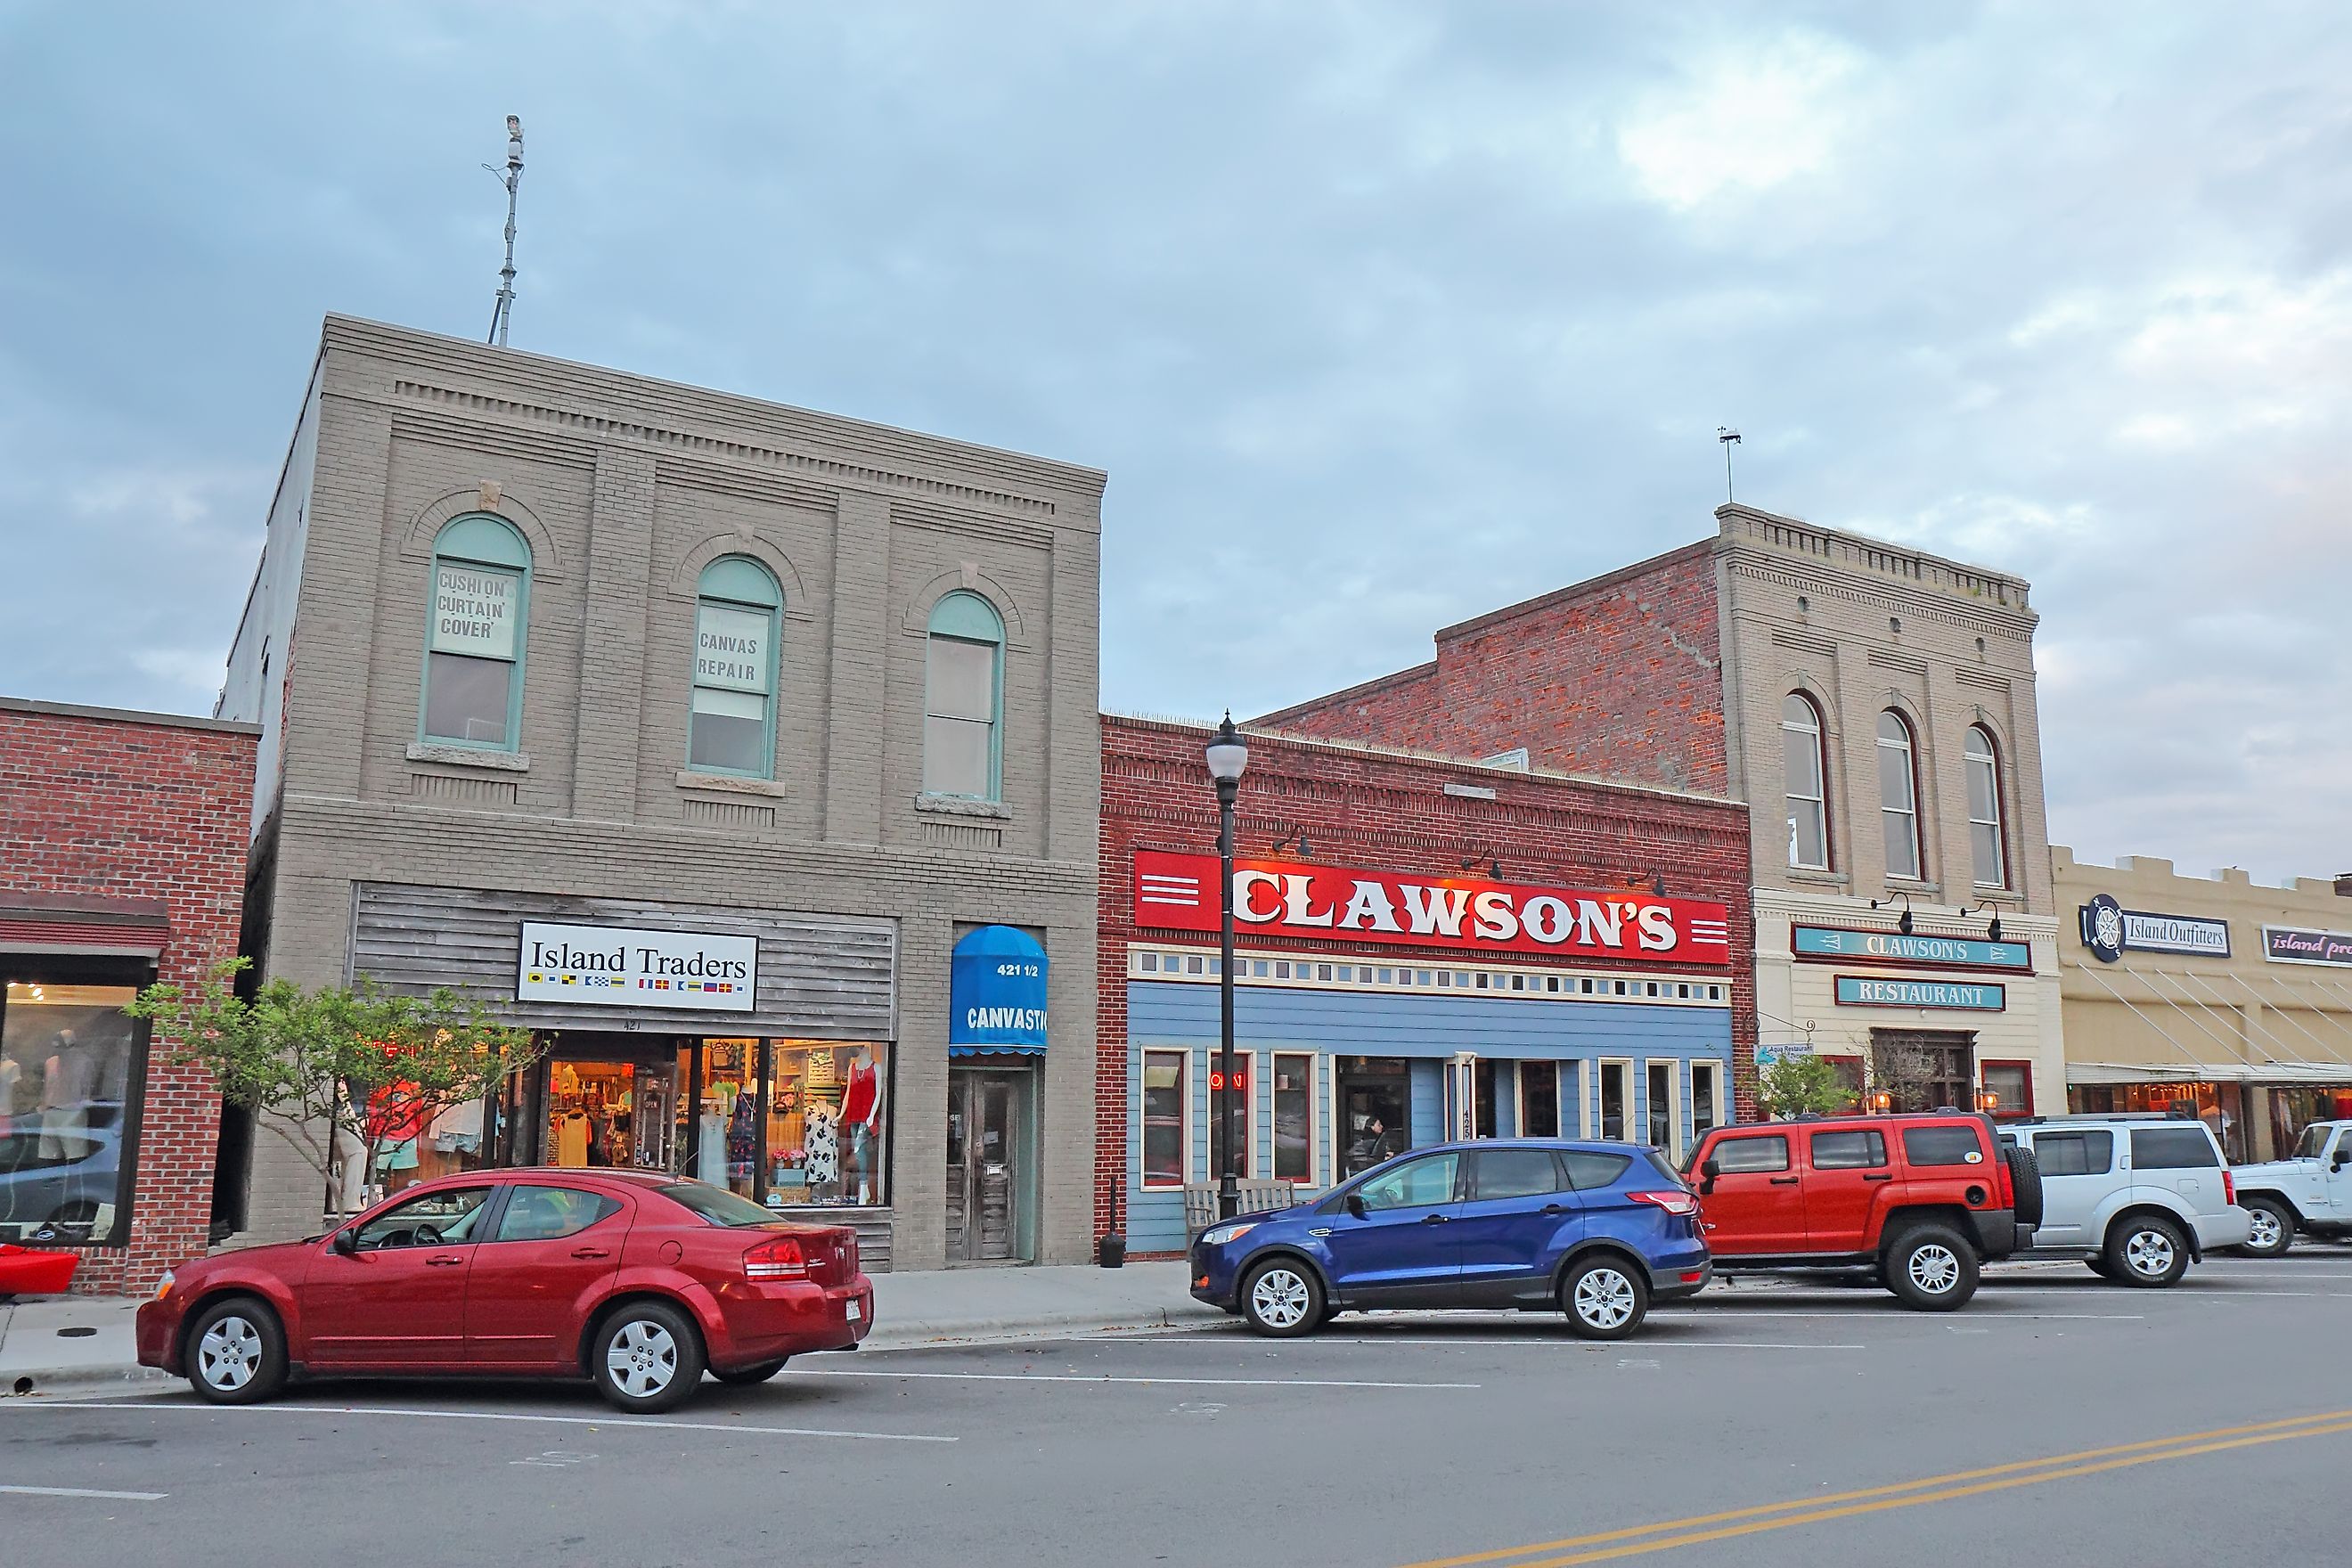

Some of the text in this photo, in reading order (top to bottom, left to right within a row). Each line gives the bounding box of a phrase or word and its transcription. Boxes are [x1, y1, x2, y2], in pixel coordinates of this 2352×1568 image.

[699, 632, 757, 655] CANVAS
[698, 657, 755, 681] REPAIR
[1233, 870, 1678, 951] CLAWSON'S
[2129, 918, 2223, 948] Island Outfitters
[2272, 933, 2328, 951] island
[1866, 936, 1967, 960] CLAWSON'S
[529, 941, 747, 979] Island Traders
[997, 964, 1039, 977] 421 1/2
[1858, 982, 1983, 1005] RESTAURANT
[624, 1020, 641, 1031] 421
